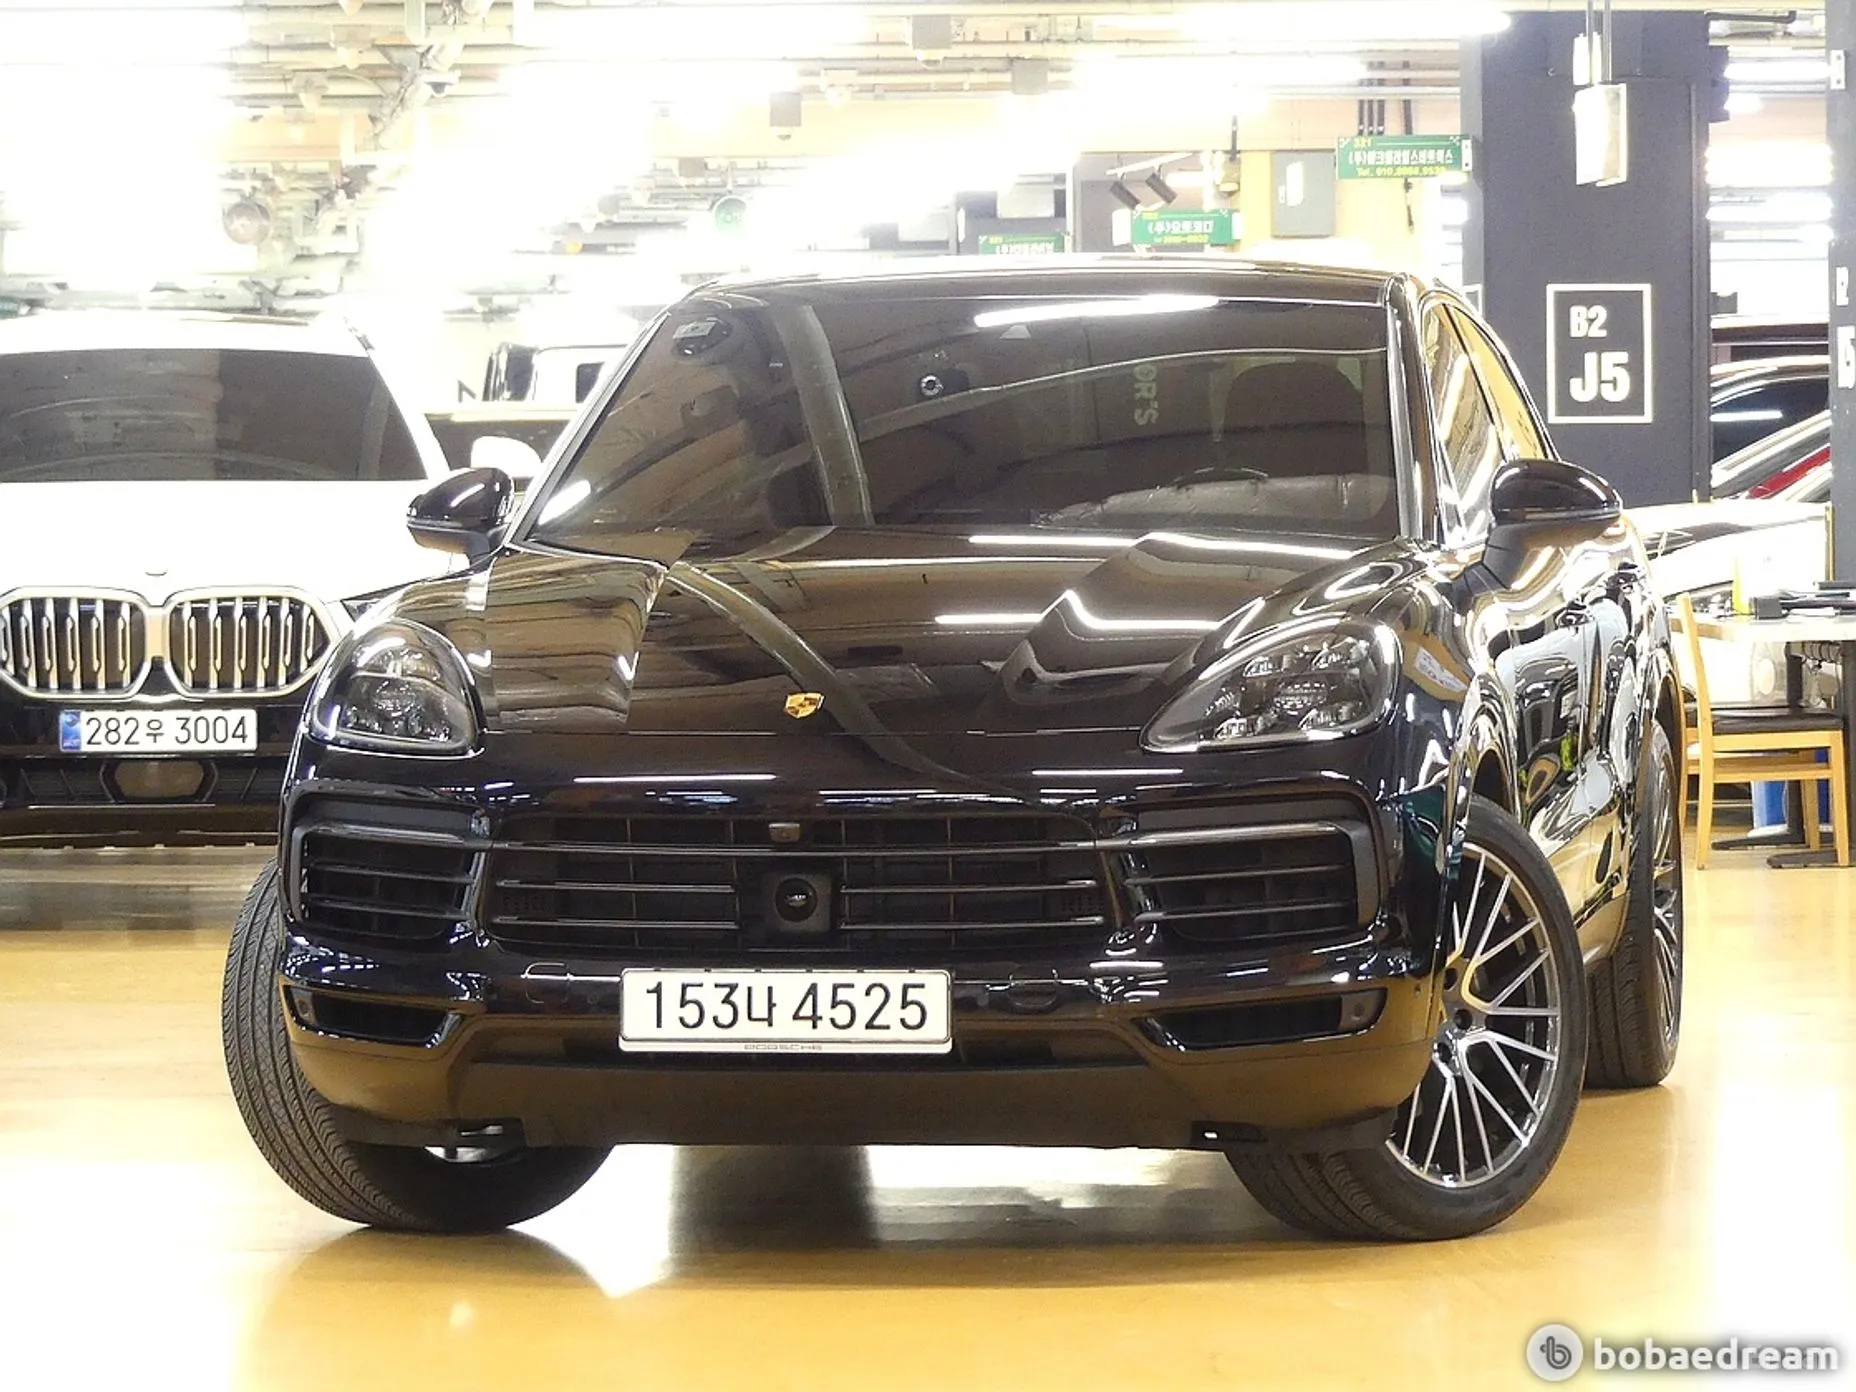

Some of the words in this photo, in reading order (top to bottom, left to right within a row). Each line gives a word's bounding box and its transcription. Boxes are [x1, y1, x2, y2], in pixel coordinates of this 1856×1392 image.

[1569, 304, 1608, 338] B2
[1569, 351, 1631, 403] J5
[86, 717, 164, 745] 282우
[175, 716, 248, 744] 3004
[646, 981, 777, 1030] 153나
[792, 982, 928, 1031] 4525
